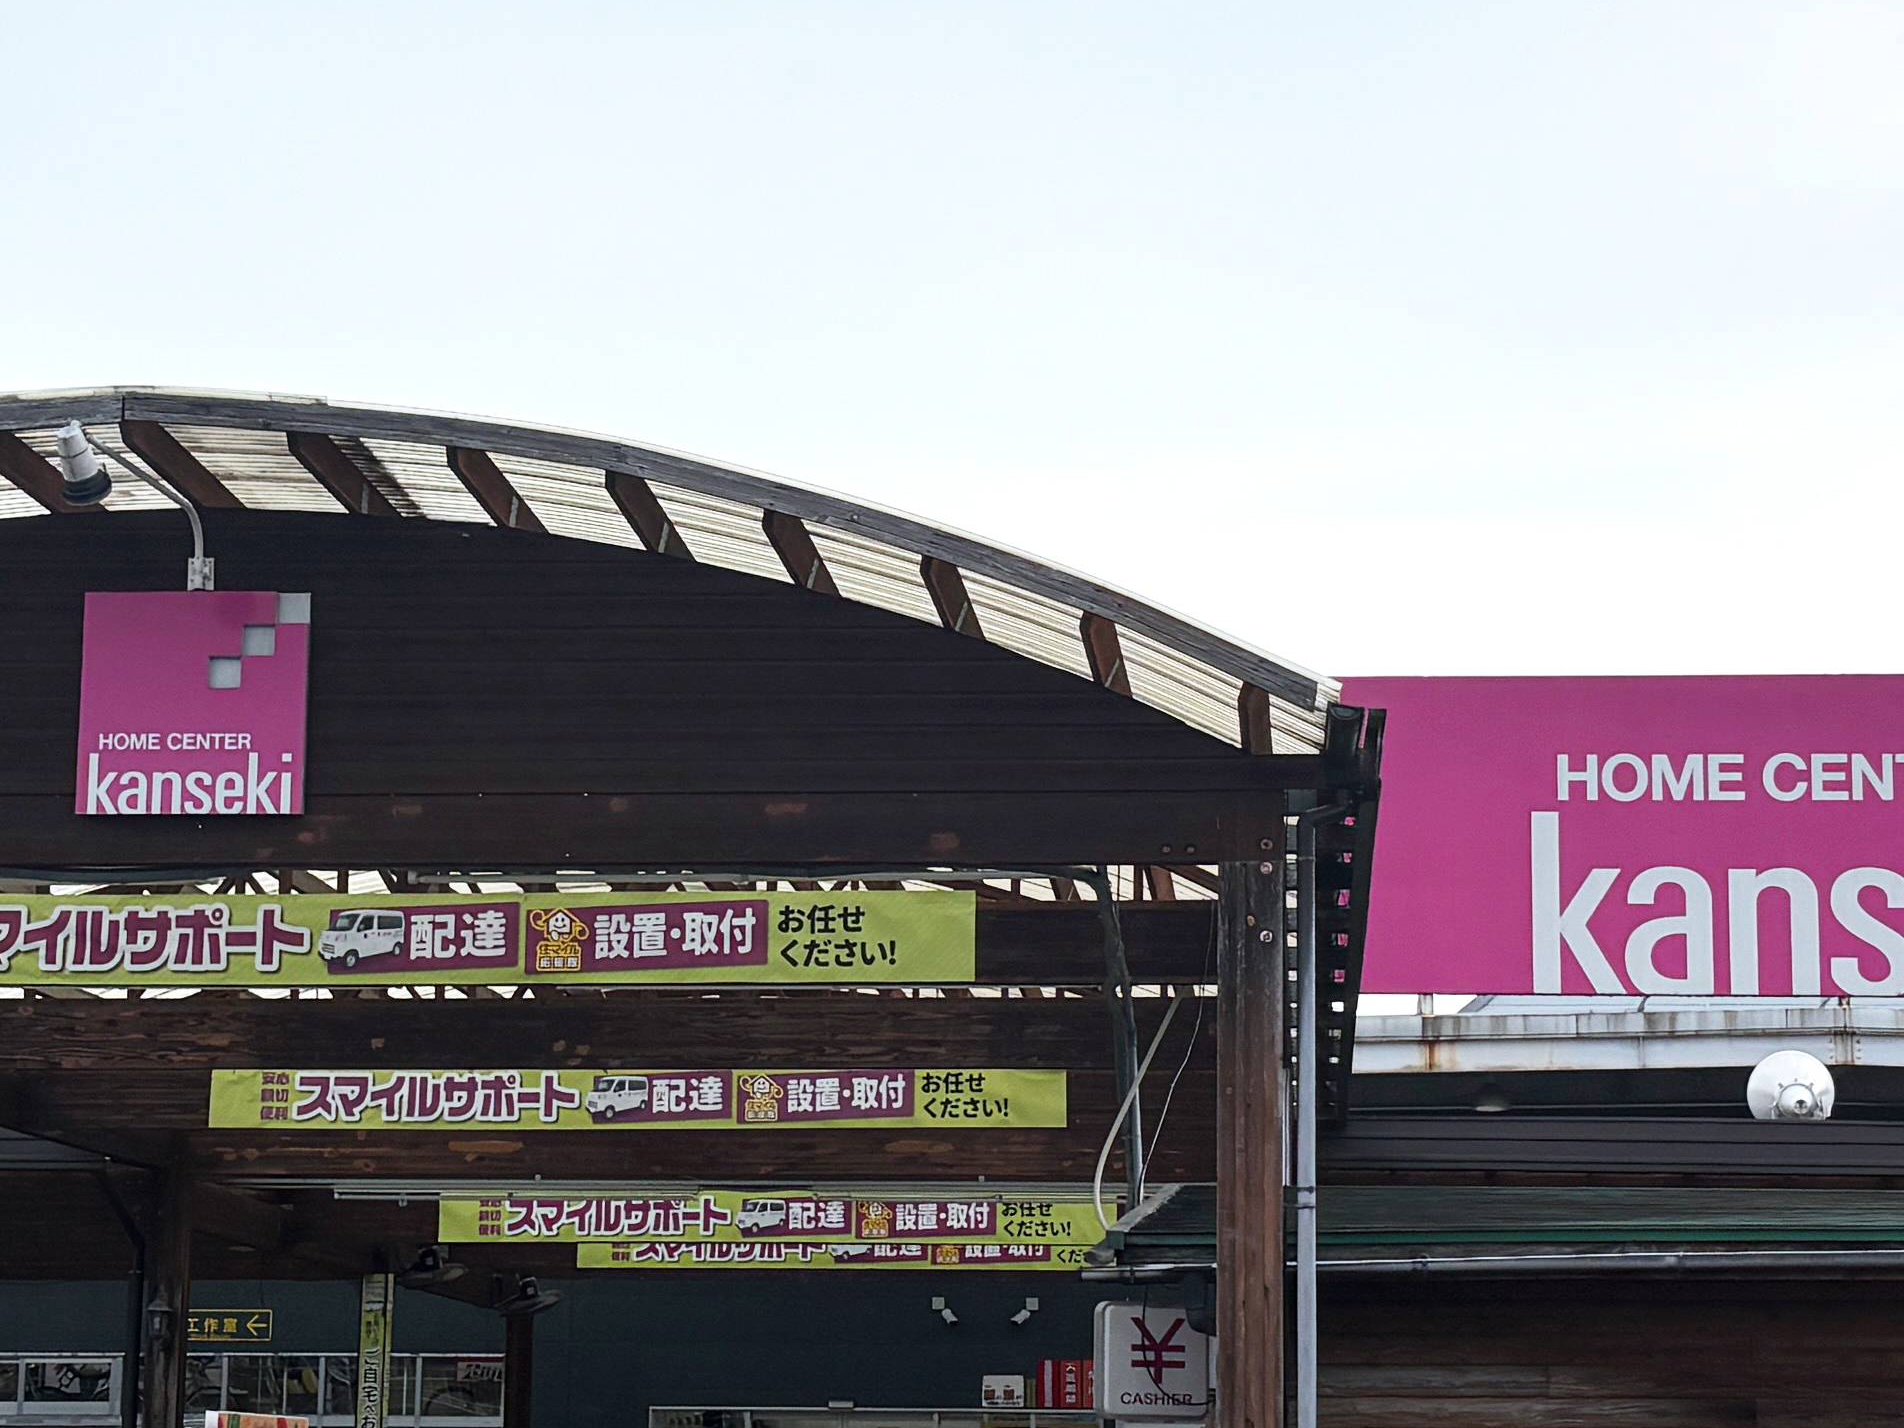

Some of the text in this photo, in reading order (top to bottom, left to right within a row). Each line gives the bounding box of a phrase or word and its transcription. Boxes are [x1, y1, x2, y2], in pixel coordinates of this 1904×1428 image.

[99, 733, 251, 750] HOME CENTER
[87, 752, 293, 814] kanseki
[1557, 754, 1746, 801] HOME
[409, 913, 507, 960] 配達
[594, 907, 756, 960] 設置・取付
[777, 904, 866, 934] お任せ
[779, 939, 898, 968] ください!
[295, 1073, 580, 1121] スマイルサポート
[652, 1076, 724, 1113] 配達
[787, 1074, 907, 1113] 設置・取付
[921, 1073, 986, 1094] お任せ
[923, 1097, 1010, 1119] ください!
[788, 1202, 845, 1230] 配達
[896, 1202, 990, 1231] 設置・取付
[1004, 1220, 1071, 1238] ください!
[1120, 1392, 1193, 1406] CASHIER
